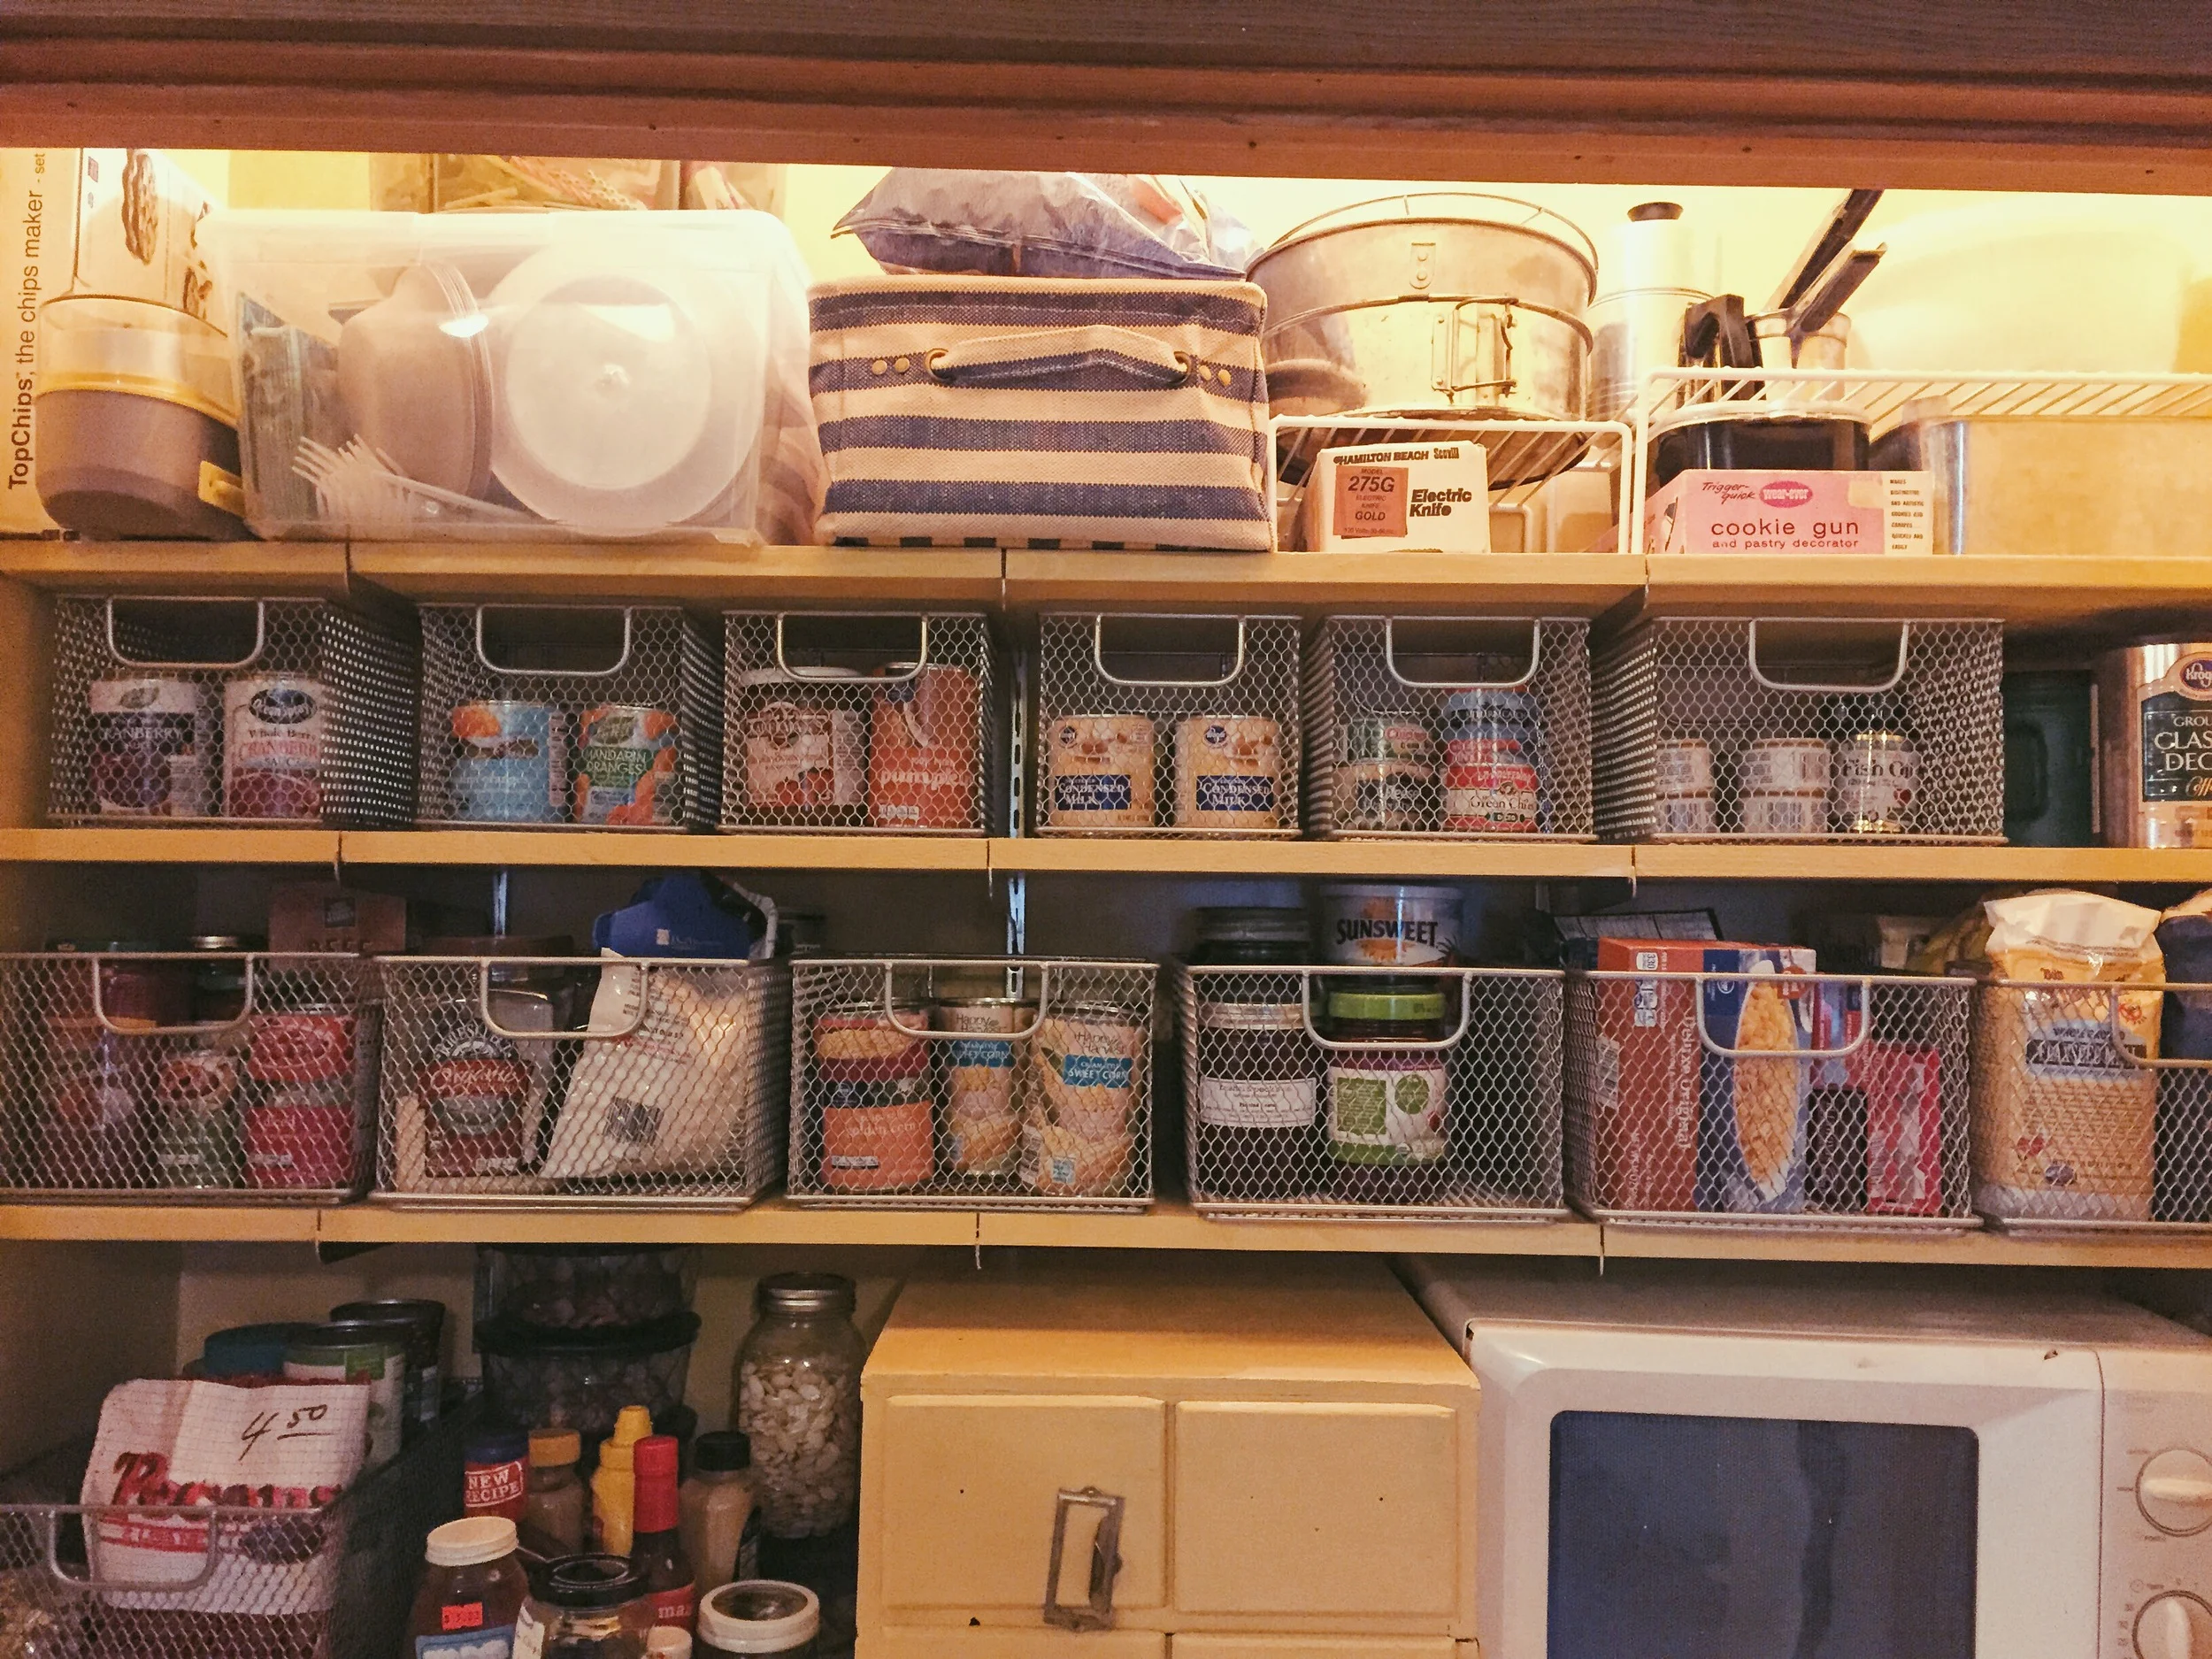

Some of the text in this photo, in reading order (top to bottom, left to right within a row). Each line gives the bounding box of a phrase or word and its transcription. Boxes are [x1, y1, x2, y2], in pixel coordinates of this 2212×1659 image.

[35, 153, 46, 176] set
[23, 191, 42, 257] maker
[17, 265, 41, 323] chips
[16, 329, 35, 367] the
[1338, 452, 1392, 466] HAMILTON
[1393, 449, 1429, 462] BEACH
[1348, 476, 1395, 493] 275G
[1411, 488, 1472, 503] Electric
[1721, 489, 1756, 504] quick
[1355, 511, 1386, 521] GOLD
[1409, 503, 1452, 518] Knife
[1711, 518, 1859, 539] cookie gun
[1712, 538, 1859, 550] and pastry decorator
[587, 749, 647, 763] MANDARIN
[586, 761, 643, 775] ORANGES
[1203, 782, 1270, 795] CONDENSED
[1212, 795, 1246, 806] MILK
[1336, 918, 1439, 948] SUNSWEET
[1647, 954, 1655, 969] 330
[956, 1014, 991, 1033] Happy
[1068, 1069, 1128, 1079] SWEET CORN
[1676, 1015, 1697, 1150] Deluxe Original
[468, 1469, 510, 1490] NEW
[465, 1481, 520, 1503] RECIPE
